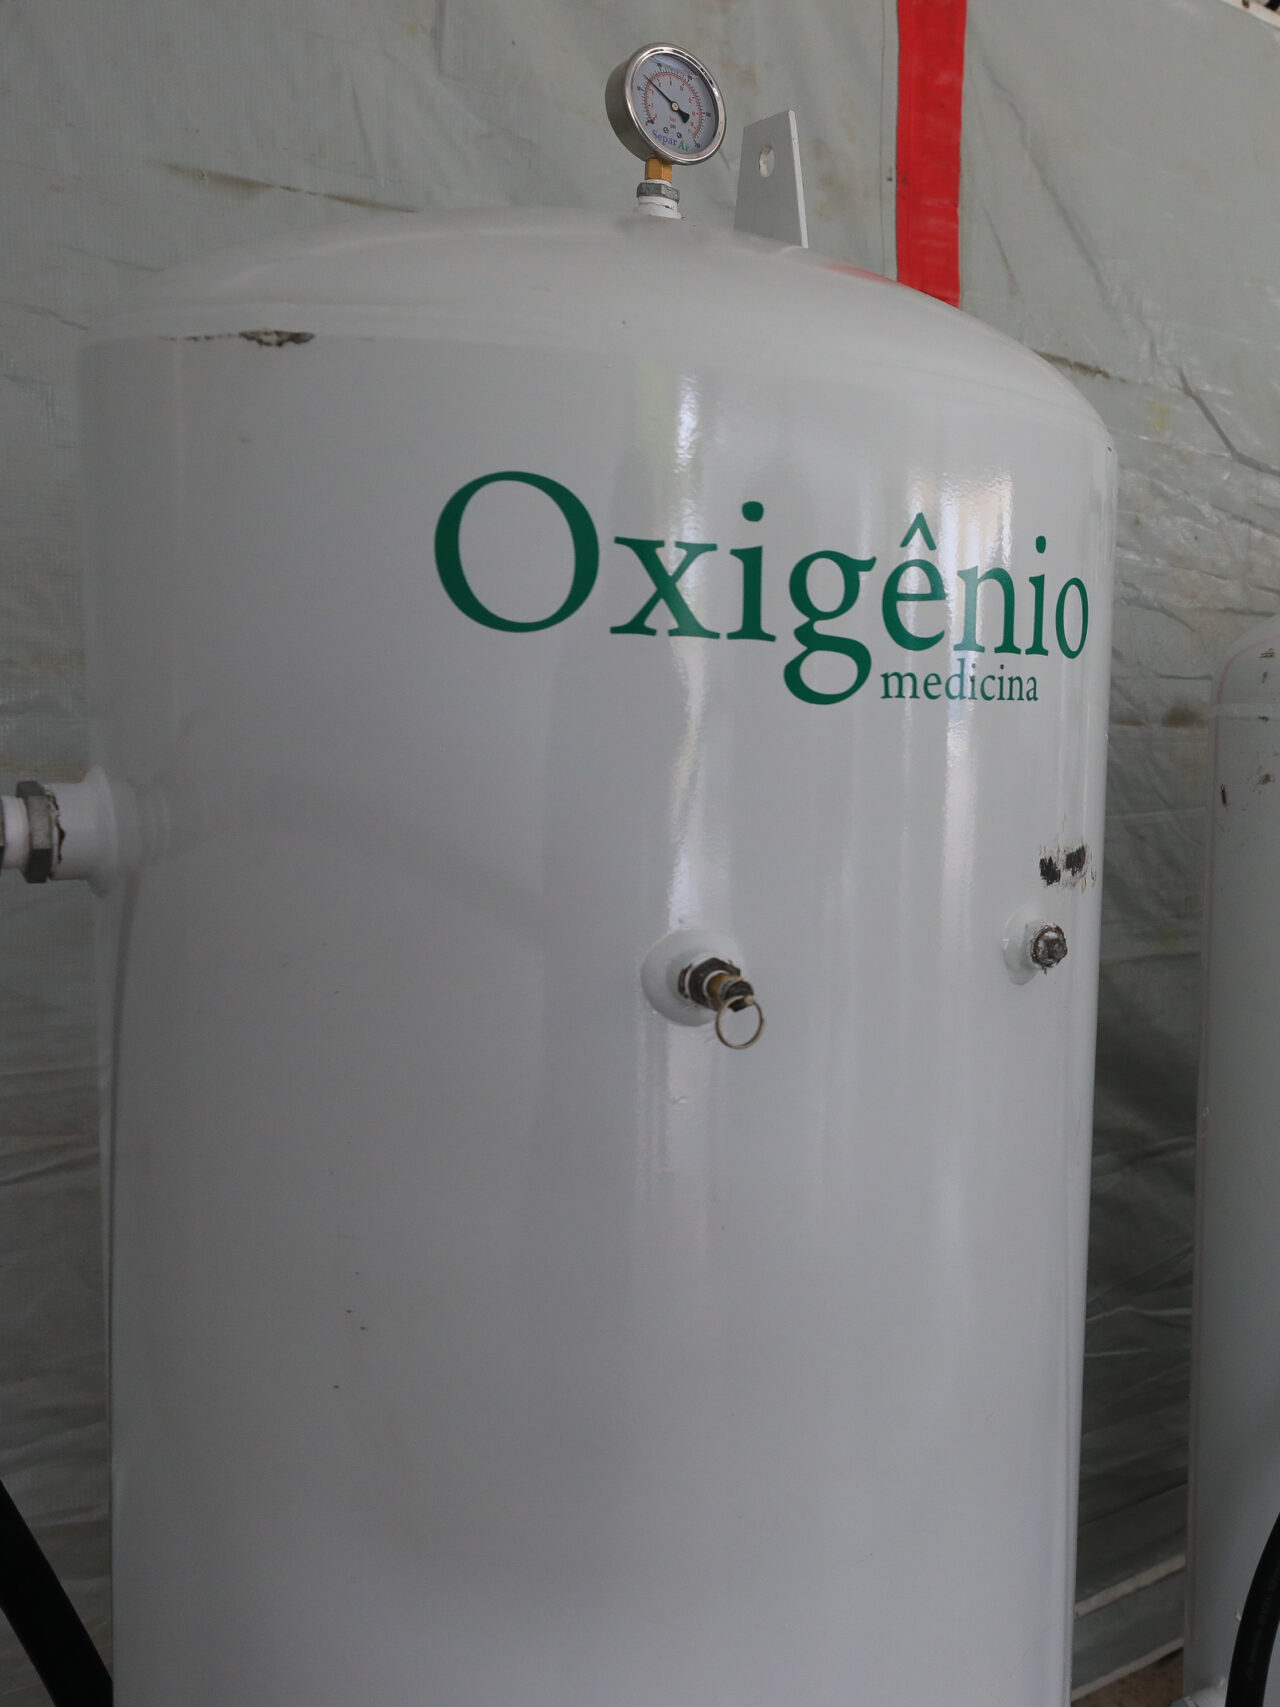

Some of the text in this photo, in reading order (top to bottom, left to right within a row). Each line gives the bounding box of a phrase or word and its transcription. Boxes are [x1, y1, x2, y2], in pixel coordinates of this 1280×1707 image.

[653, 130, 677, 145] Separ
[434, 470, 1089, 705] Oxigênio
[880, 658, 1039, 702] medicina
